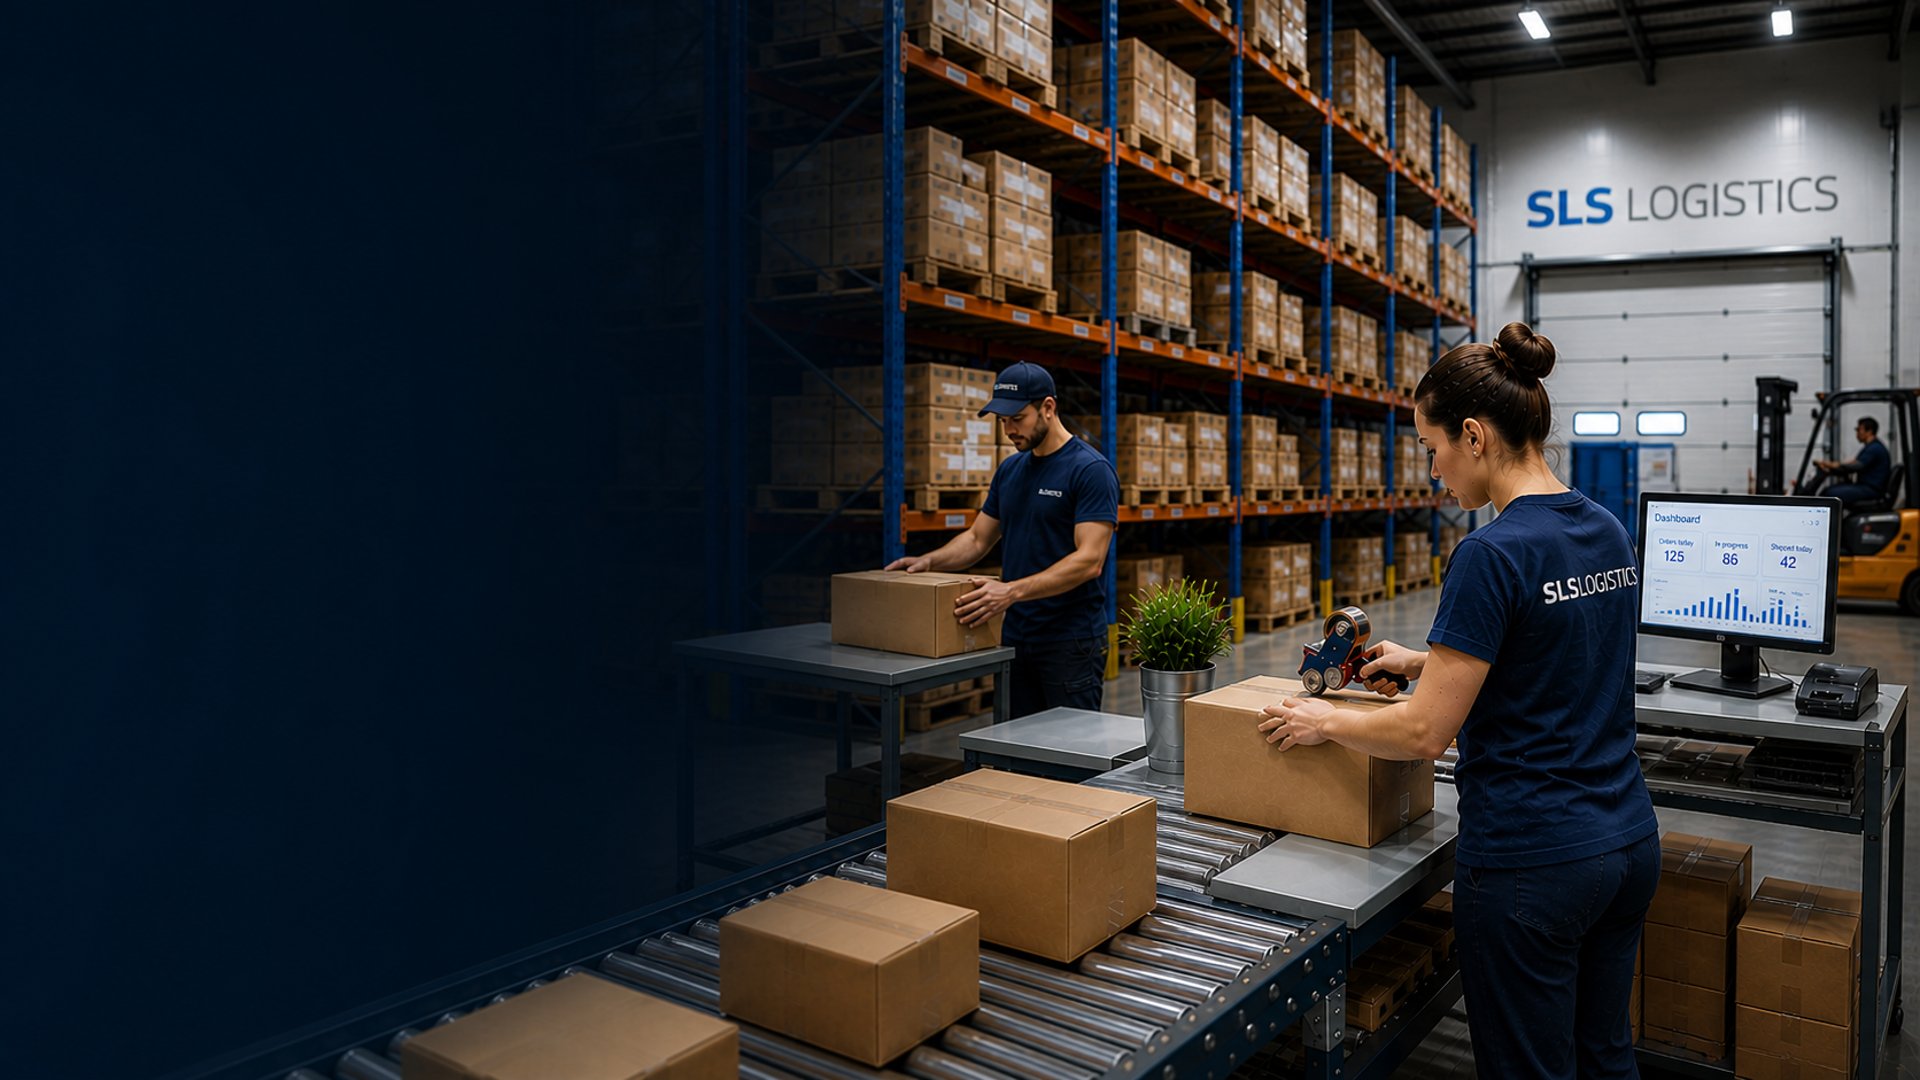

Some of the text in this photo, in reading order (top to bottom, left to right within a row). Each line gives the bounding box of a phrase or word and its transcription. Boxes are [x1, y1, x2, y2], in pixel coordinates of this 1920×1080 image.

[1527, 176, 1838, 228] SLS LOGISTICS
[1655, 513, 1701, 524] Dashboard
[1664, 550, 1684, 562] 125
[1722, 553, 1738, 565] 86
[1780, 556, 1796, 568] 42
